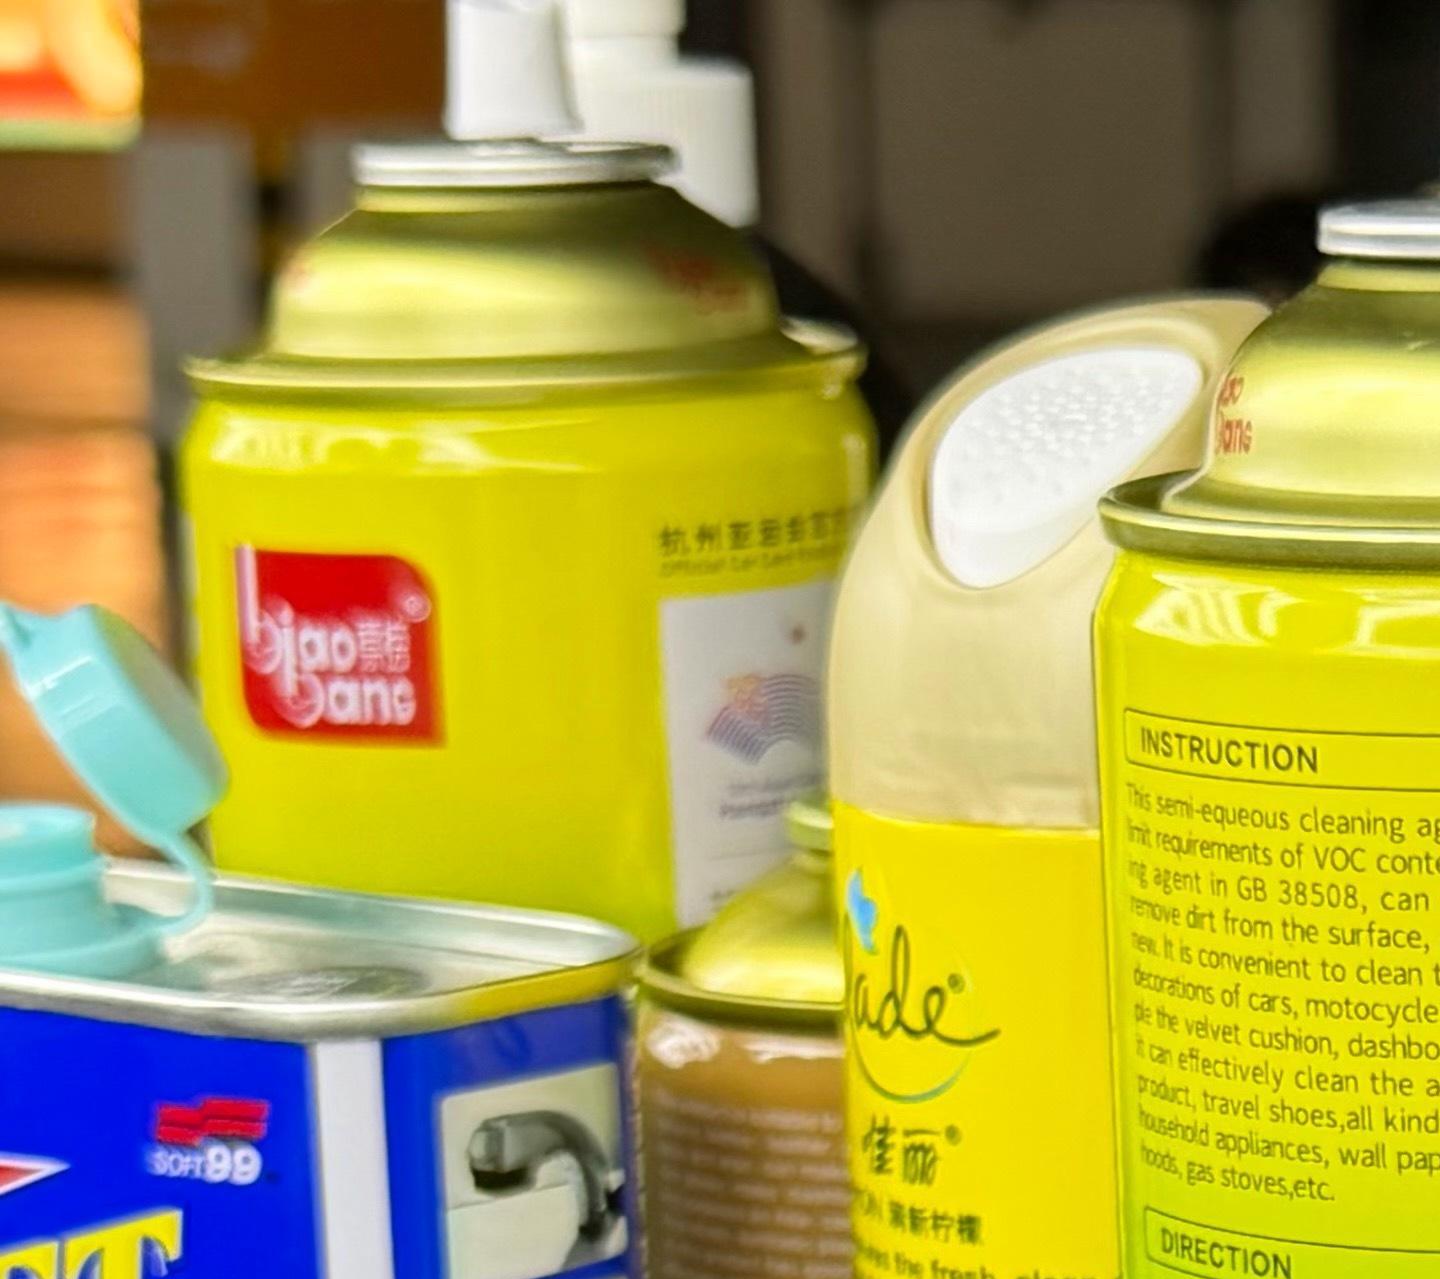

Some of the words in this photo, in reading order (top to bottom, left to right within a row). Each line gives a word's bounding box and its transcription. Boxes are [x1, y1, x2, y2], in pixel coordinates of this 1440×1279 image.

[1141, 727, 1318, 774] INSTRUCTION
[1157, 796, 1290, 831] semi-equeous
[1300, 807, 1405, 844] cleaning
[1280, 842, 1303, 868] of
[1314, 846, 1365, 872] VOC
[1237, 876, 1267, 902] GB
[1279, 880, 1367, 914] 38508,
[1381, 892, 1429, 911] can
[1339, 1143, 1386, 1168] wall
